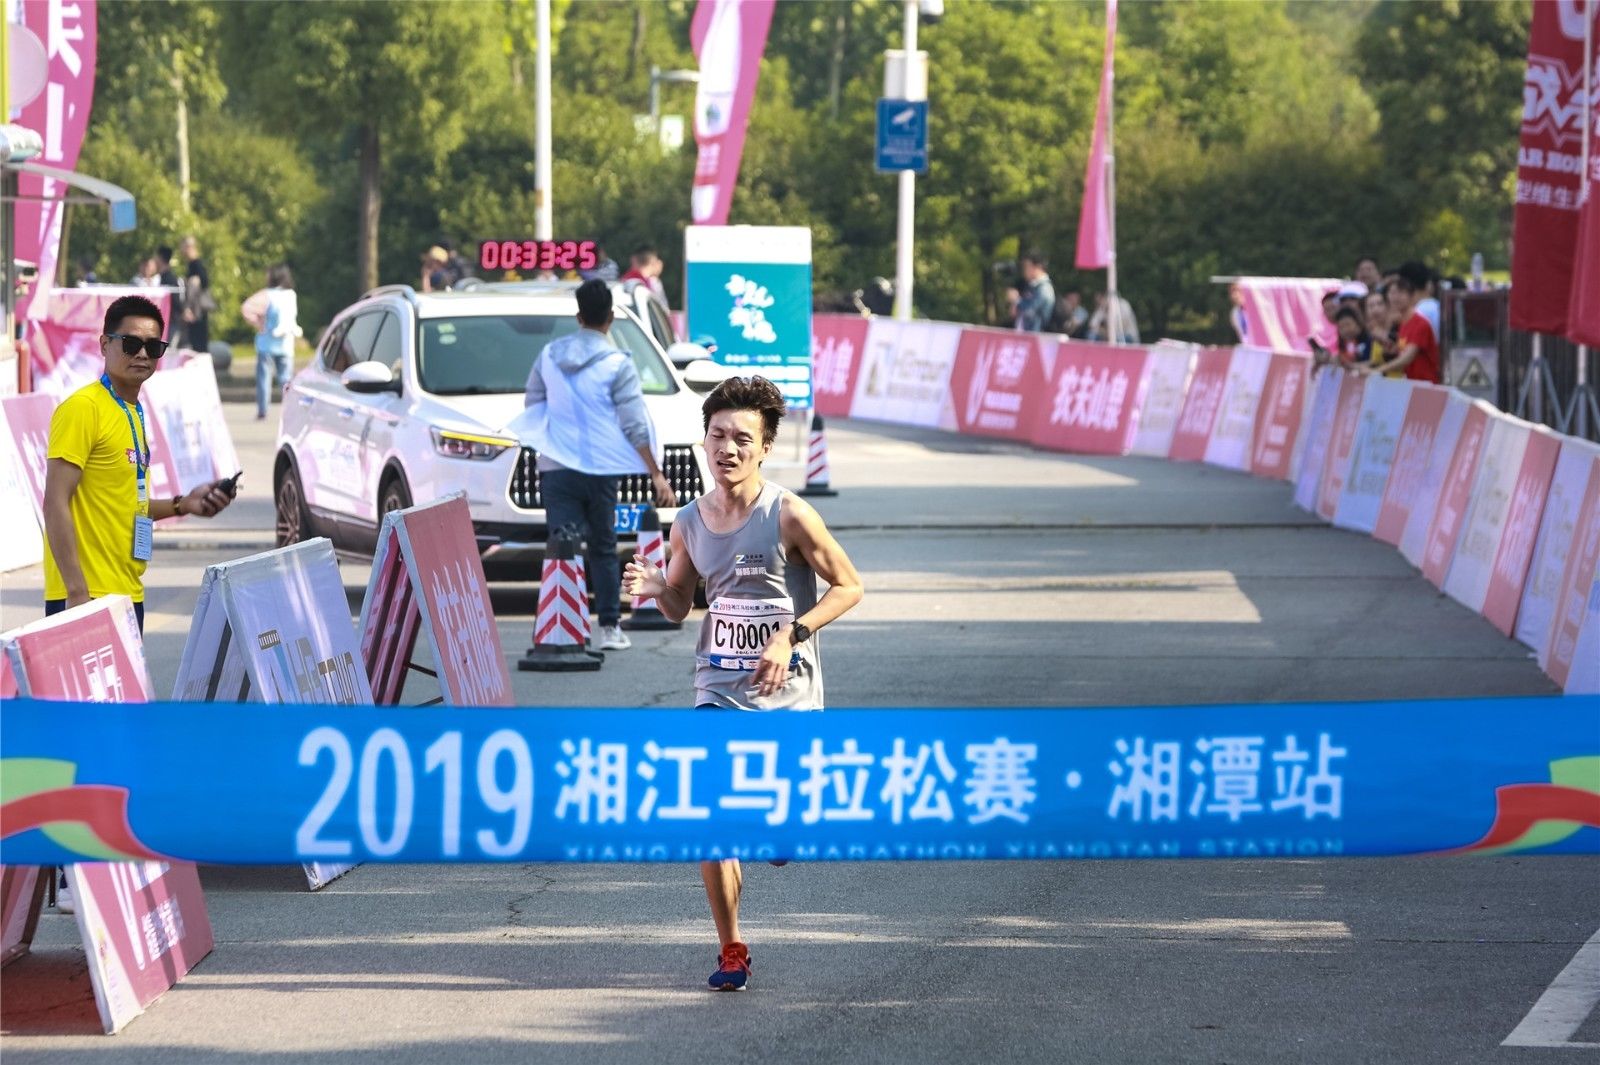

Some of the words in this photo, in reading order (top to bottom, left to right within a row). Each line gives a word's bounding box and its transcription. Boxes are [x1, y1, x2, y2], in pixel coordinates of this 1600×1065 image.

[480, 240, 597, 270] 00:33:25
[1050, 364, 1129, 432] 农夫山泉
[295, 726, 534, 857] 2019
[554, 733, 1347, 827] 湘江马拉松赛·湘潭站
[795, 843, 987, 860] MARATHON
[1197, 838, 1345, 857] STATION
